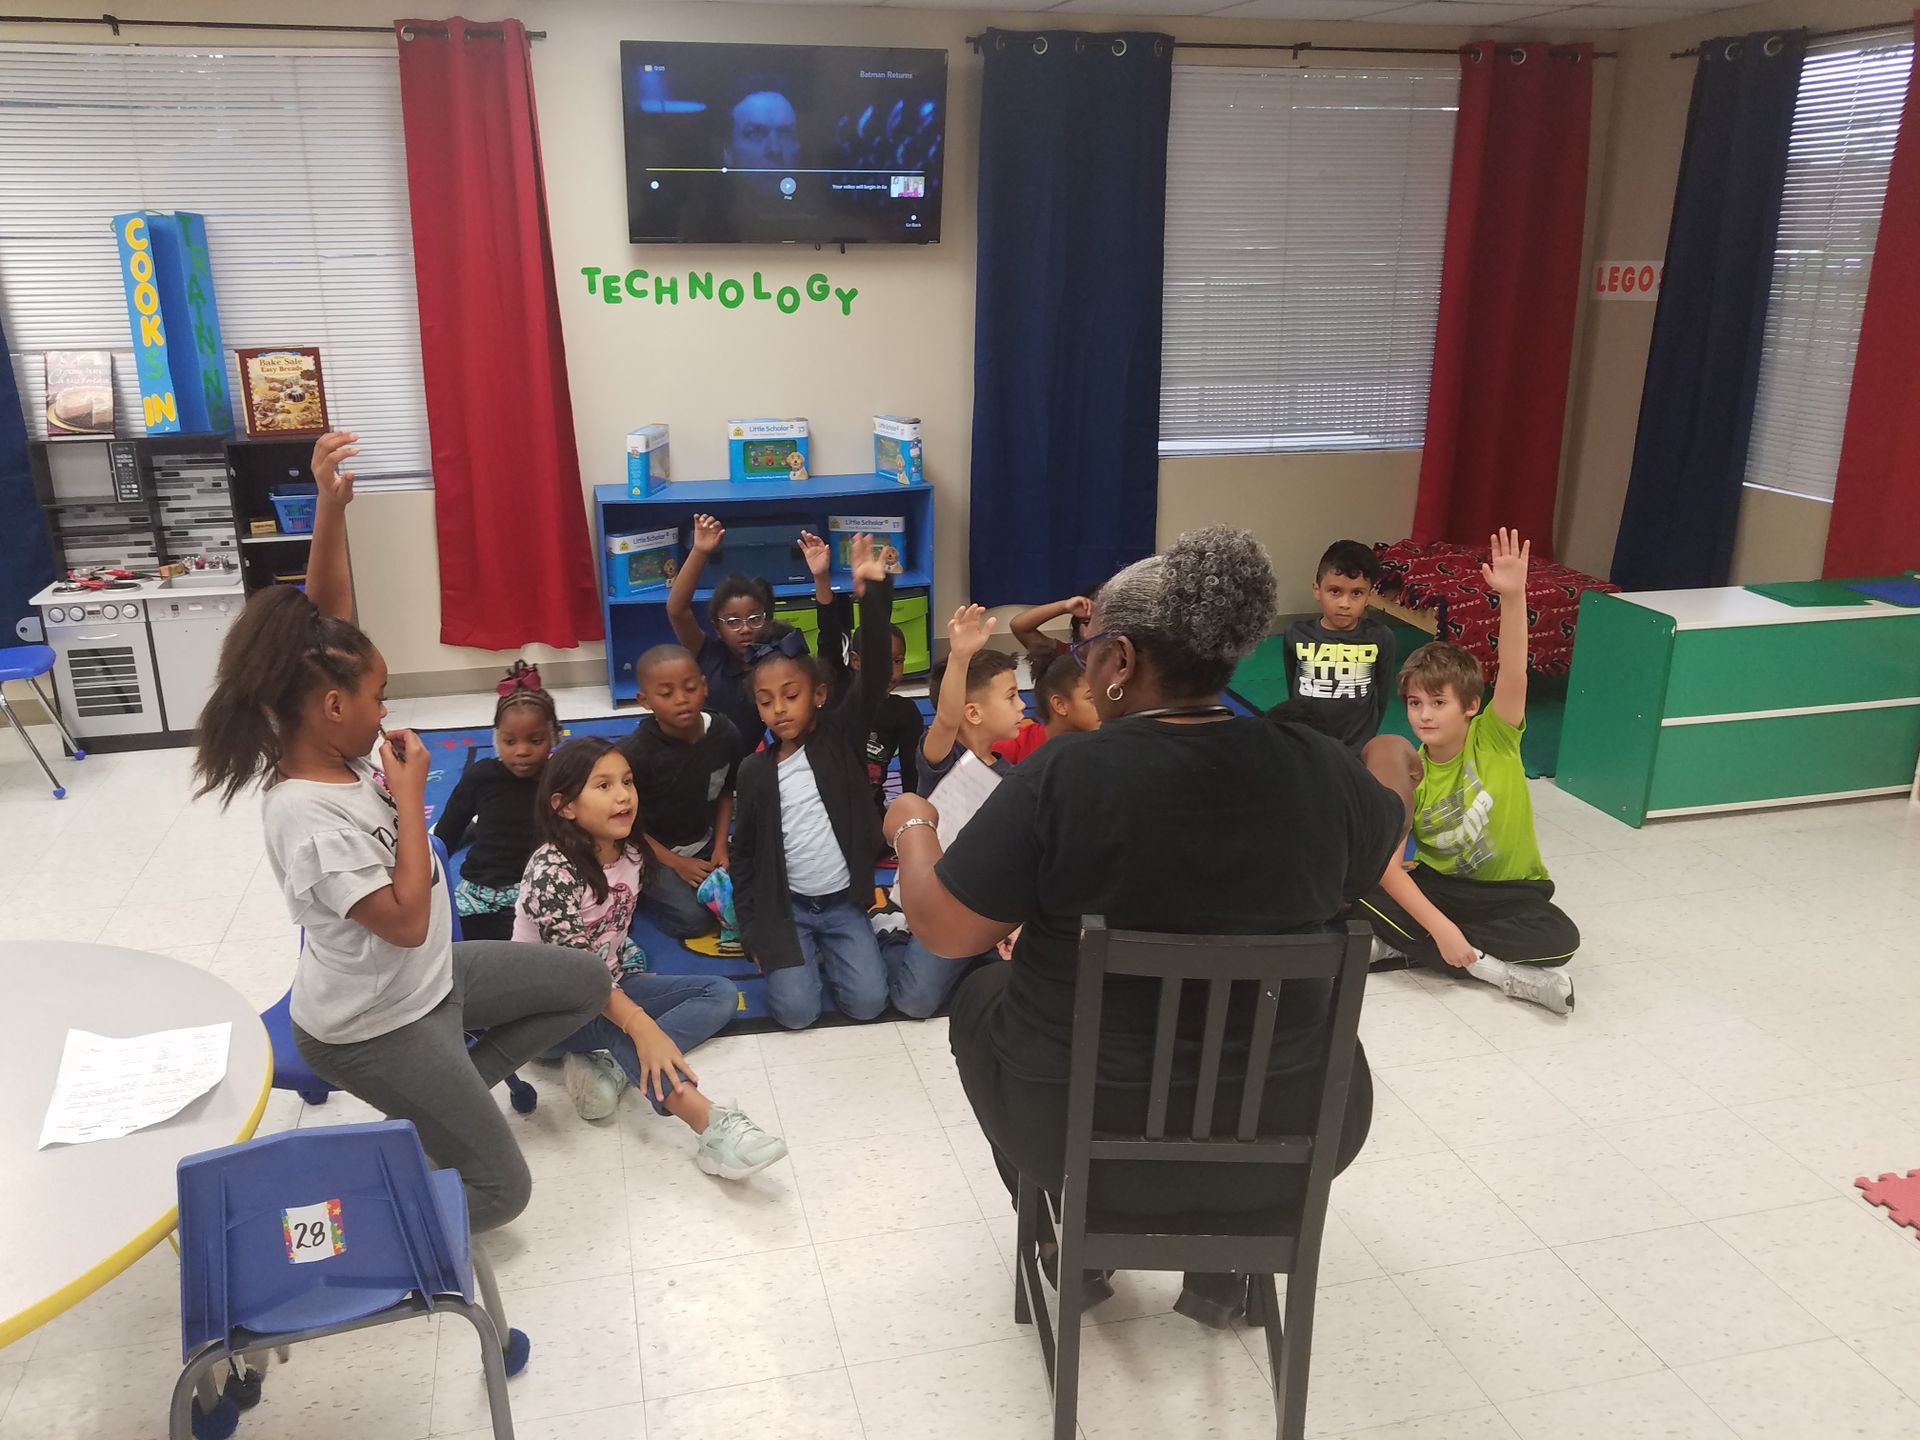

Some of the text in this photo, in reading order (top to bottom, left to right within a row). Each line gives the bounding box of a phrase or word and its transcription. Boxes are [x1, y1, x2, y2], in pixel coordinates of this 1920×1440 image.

[860, 70, 913, 79] Batman Returns
[1595, 265, 1664, 293] LEGO
[125, 217, 165, 379] COOKS
[581, 267, 858, 316] TECHNOLOGY
[177, 215, 230, 430] TRAINING
[143, 391, 177, 427] IN
[749, 425, 765, 433] Little
[1528, 588, 1557, 596] XANS
[1447, 599, 1481, 612] XANS
[1551, 605, 1580, 614] TEXA
[1528, 630, 1555, 639] XANS
[1296, 643, 1379, 662] HARD
[1314, 661, 1357, 680] TO
[1299, 676, 1372, 699] BEAT
[294, 1221, 326, 1249] 28
